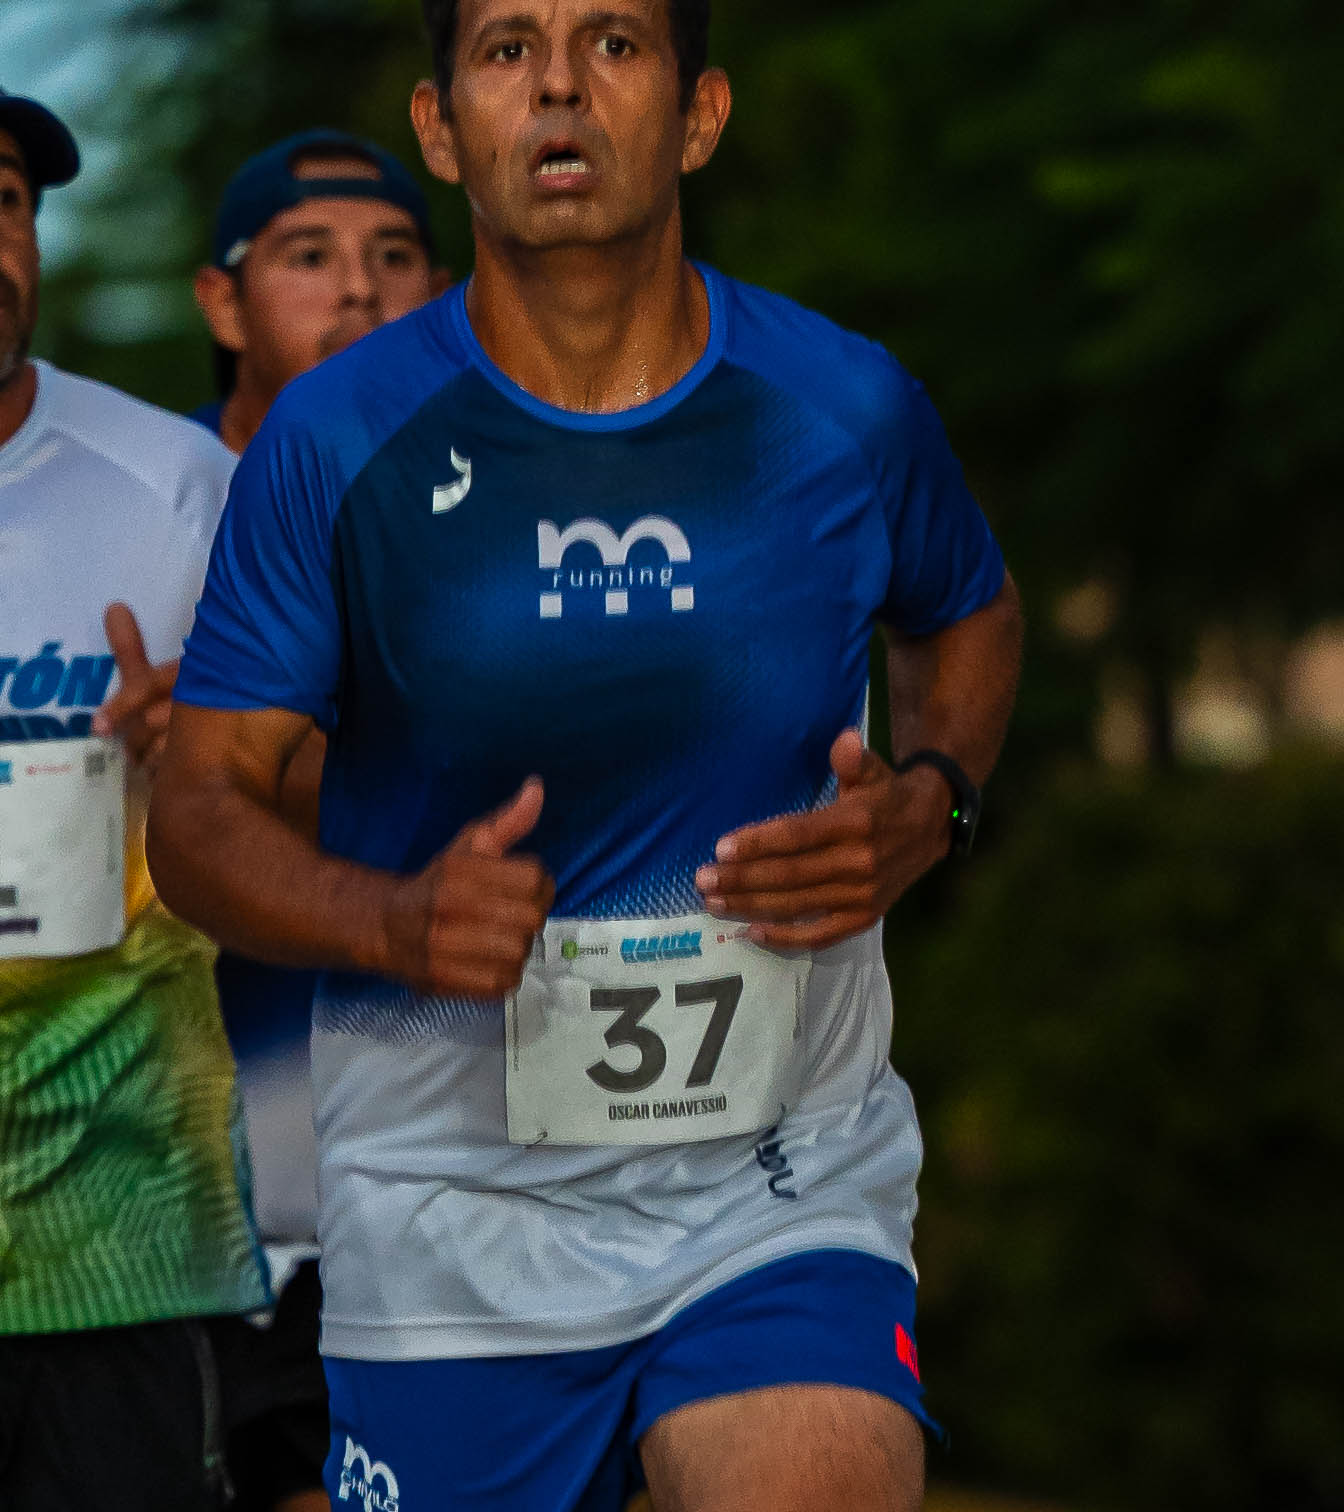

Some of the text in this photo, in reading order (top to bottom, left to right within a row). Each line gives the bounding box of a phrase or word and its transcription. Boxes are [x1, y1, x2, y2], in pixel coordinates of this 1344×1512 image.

[553, 563, 672, 589] running
[585, 974, 744, 1094] 37
[608, 1103, 650, 1121] OSCAR
